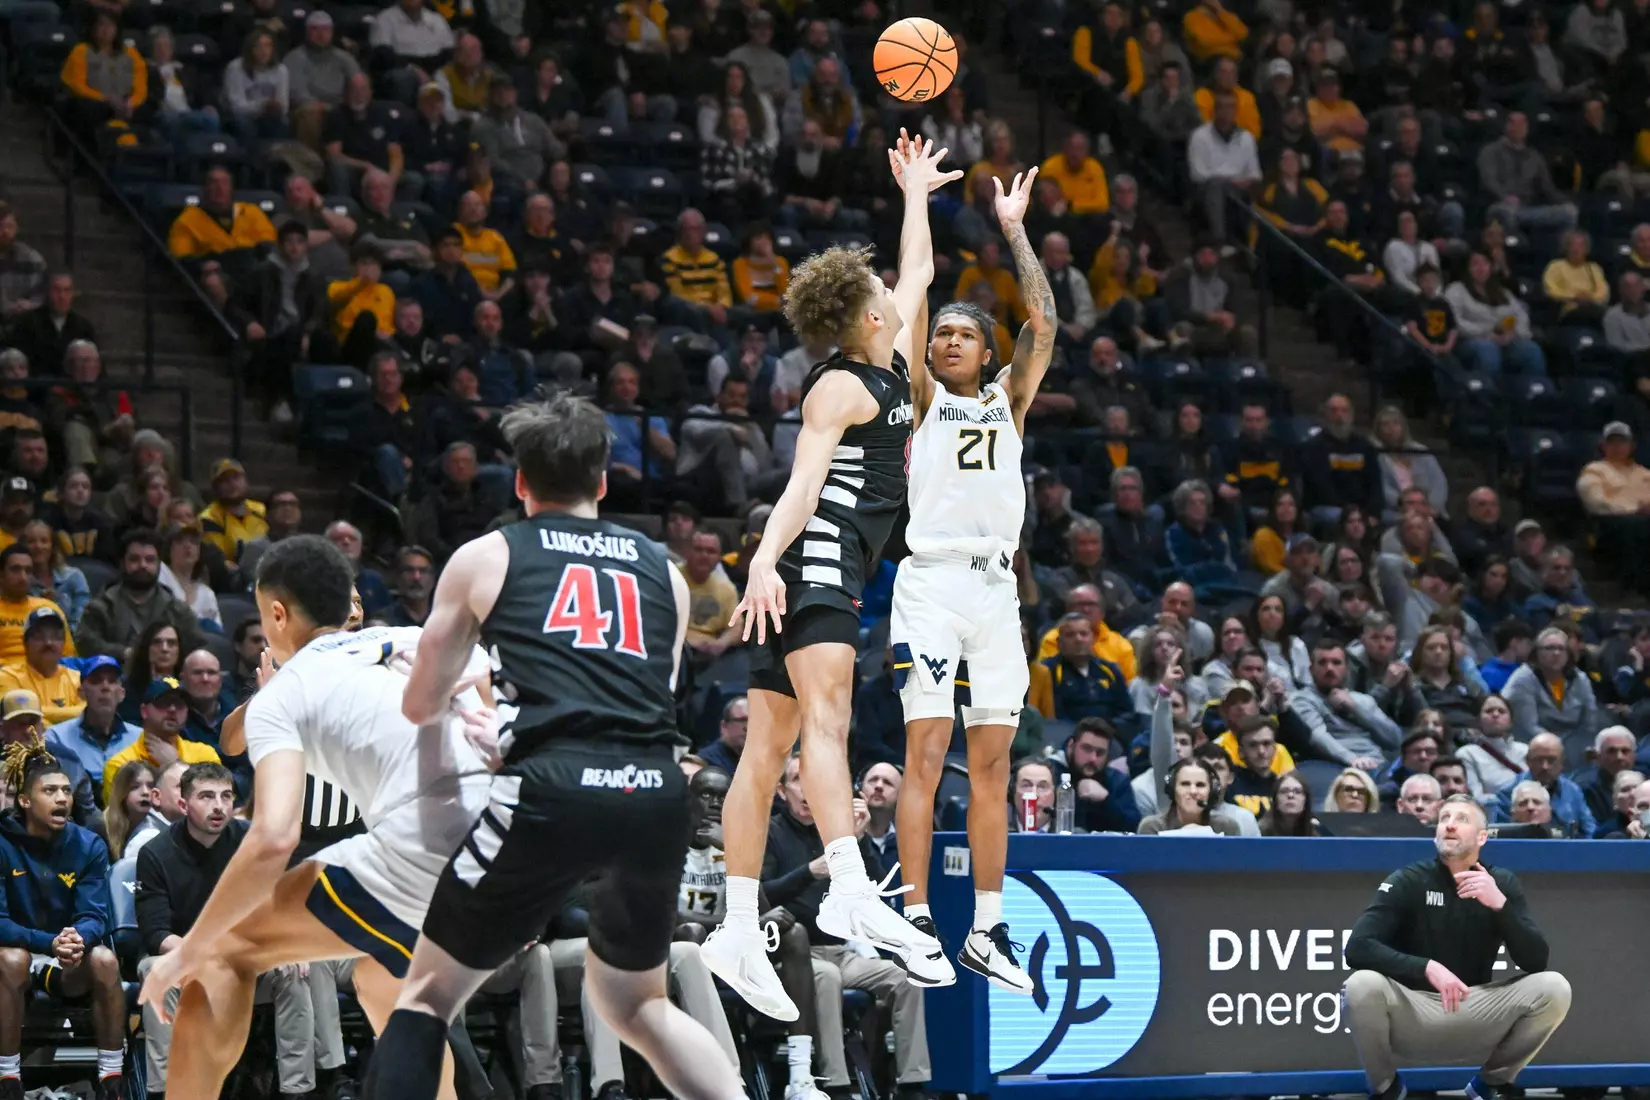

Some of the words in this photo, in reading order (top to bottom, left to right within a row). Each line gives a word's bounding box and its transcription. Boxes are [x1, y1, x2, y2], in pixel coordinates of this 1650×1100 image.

[957, 429, 998, 470] 21
[540, 528, 639, 561] LUKOŠIUS
[970, 555, 989, 572] WVU
[543, 563, 648, 660] 41
[581, 763, 664, 789] BEARCATS
[1425, 890, 1445, 907] WVU
